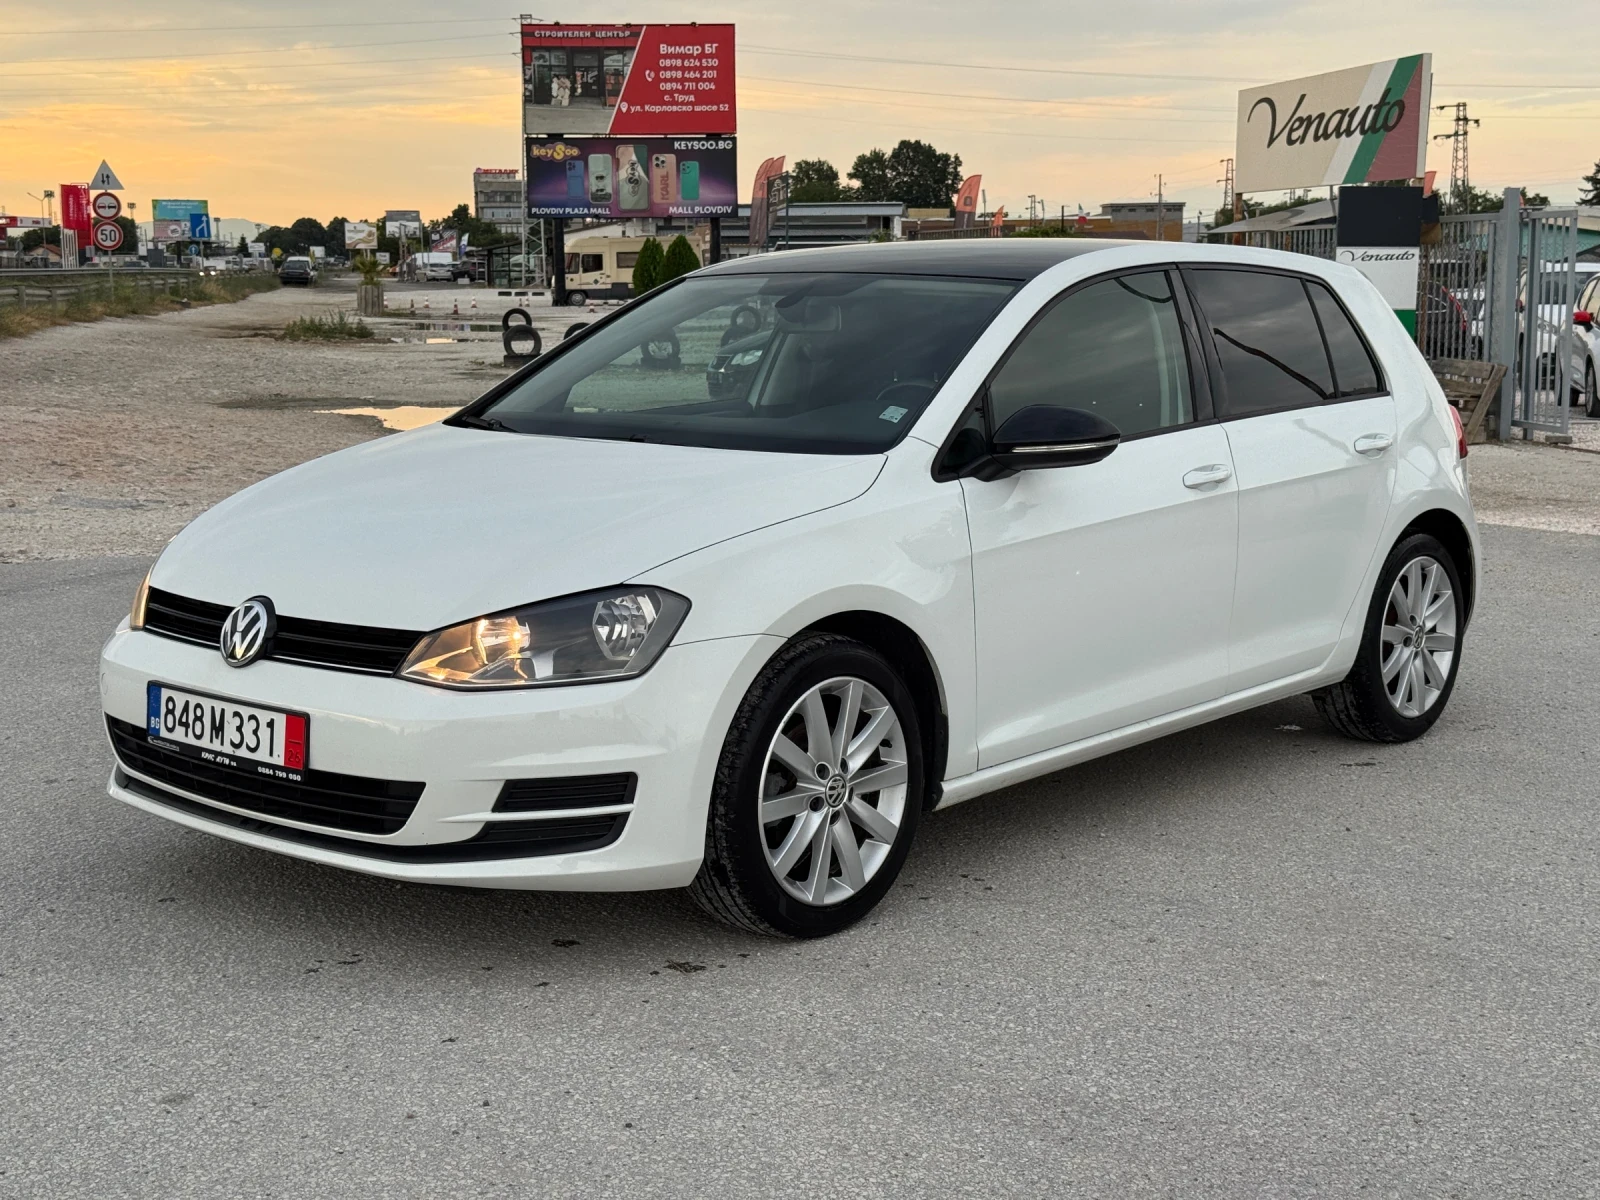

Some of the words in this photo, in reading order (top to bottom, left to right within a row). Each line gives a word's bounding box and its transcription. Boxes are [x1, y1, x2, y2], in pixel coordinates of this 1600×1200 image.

[534, 30, 591, 38] СТРОИТЕЛЕН
[595, 30, 631, 39] ЦЕНТЪР
[659, 43, 702, 56] Вимар
[704, 43, 719, 54] БГ
[659, 58, 682, 67] 0898
[683, 58, 700, 67] 624
[701, 58, 719, 67] 530
[659, 70, 682, 79] 0898
[684, 70, 700, 79] 464
[702, 70, 717, 79] 201
[659, 82, 682, 91] 0894
[683, 82, 696, 91] 711
[697, 82, 716, 91] 004
[673, 93, 696, 103] Труд
[630, 105, 643, 114] ул.
[644, 104, 693, 114] Карловско
[719, 104, 730, 112] 52
[1247, 87, 1406, 149] Venauto
[674, 140, 733, 150] KEYSOO.BG
[532, 144, 579, 160] keySoo
[660, 171, 670, 201] KARL
[590, 207, 611, 215] MALL
[669, 206, 693, 214] MALL
[694, 205, 733, 214] PLOVDIV
[100, 228, 117, 243] 50
[1340, 250, 1415, 262] Venauto
[150, 716, 160, 729] BG
